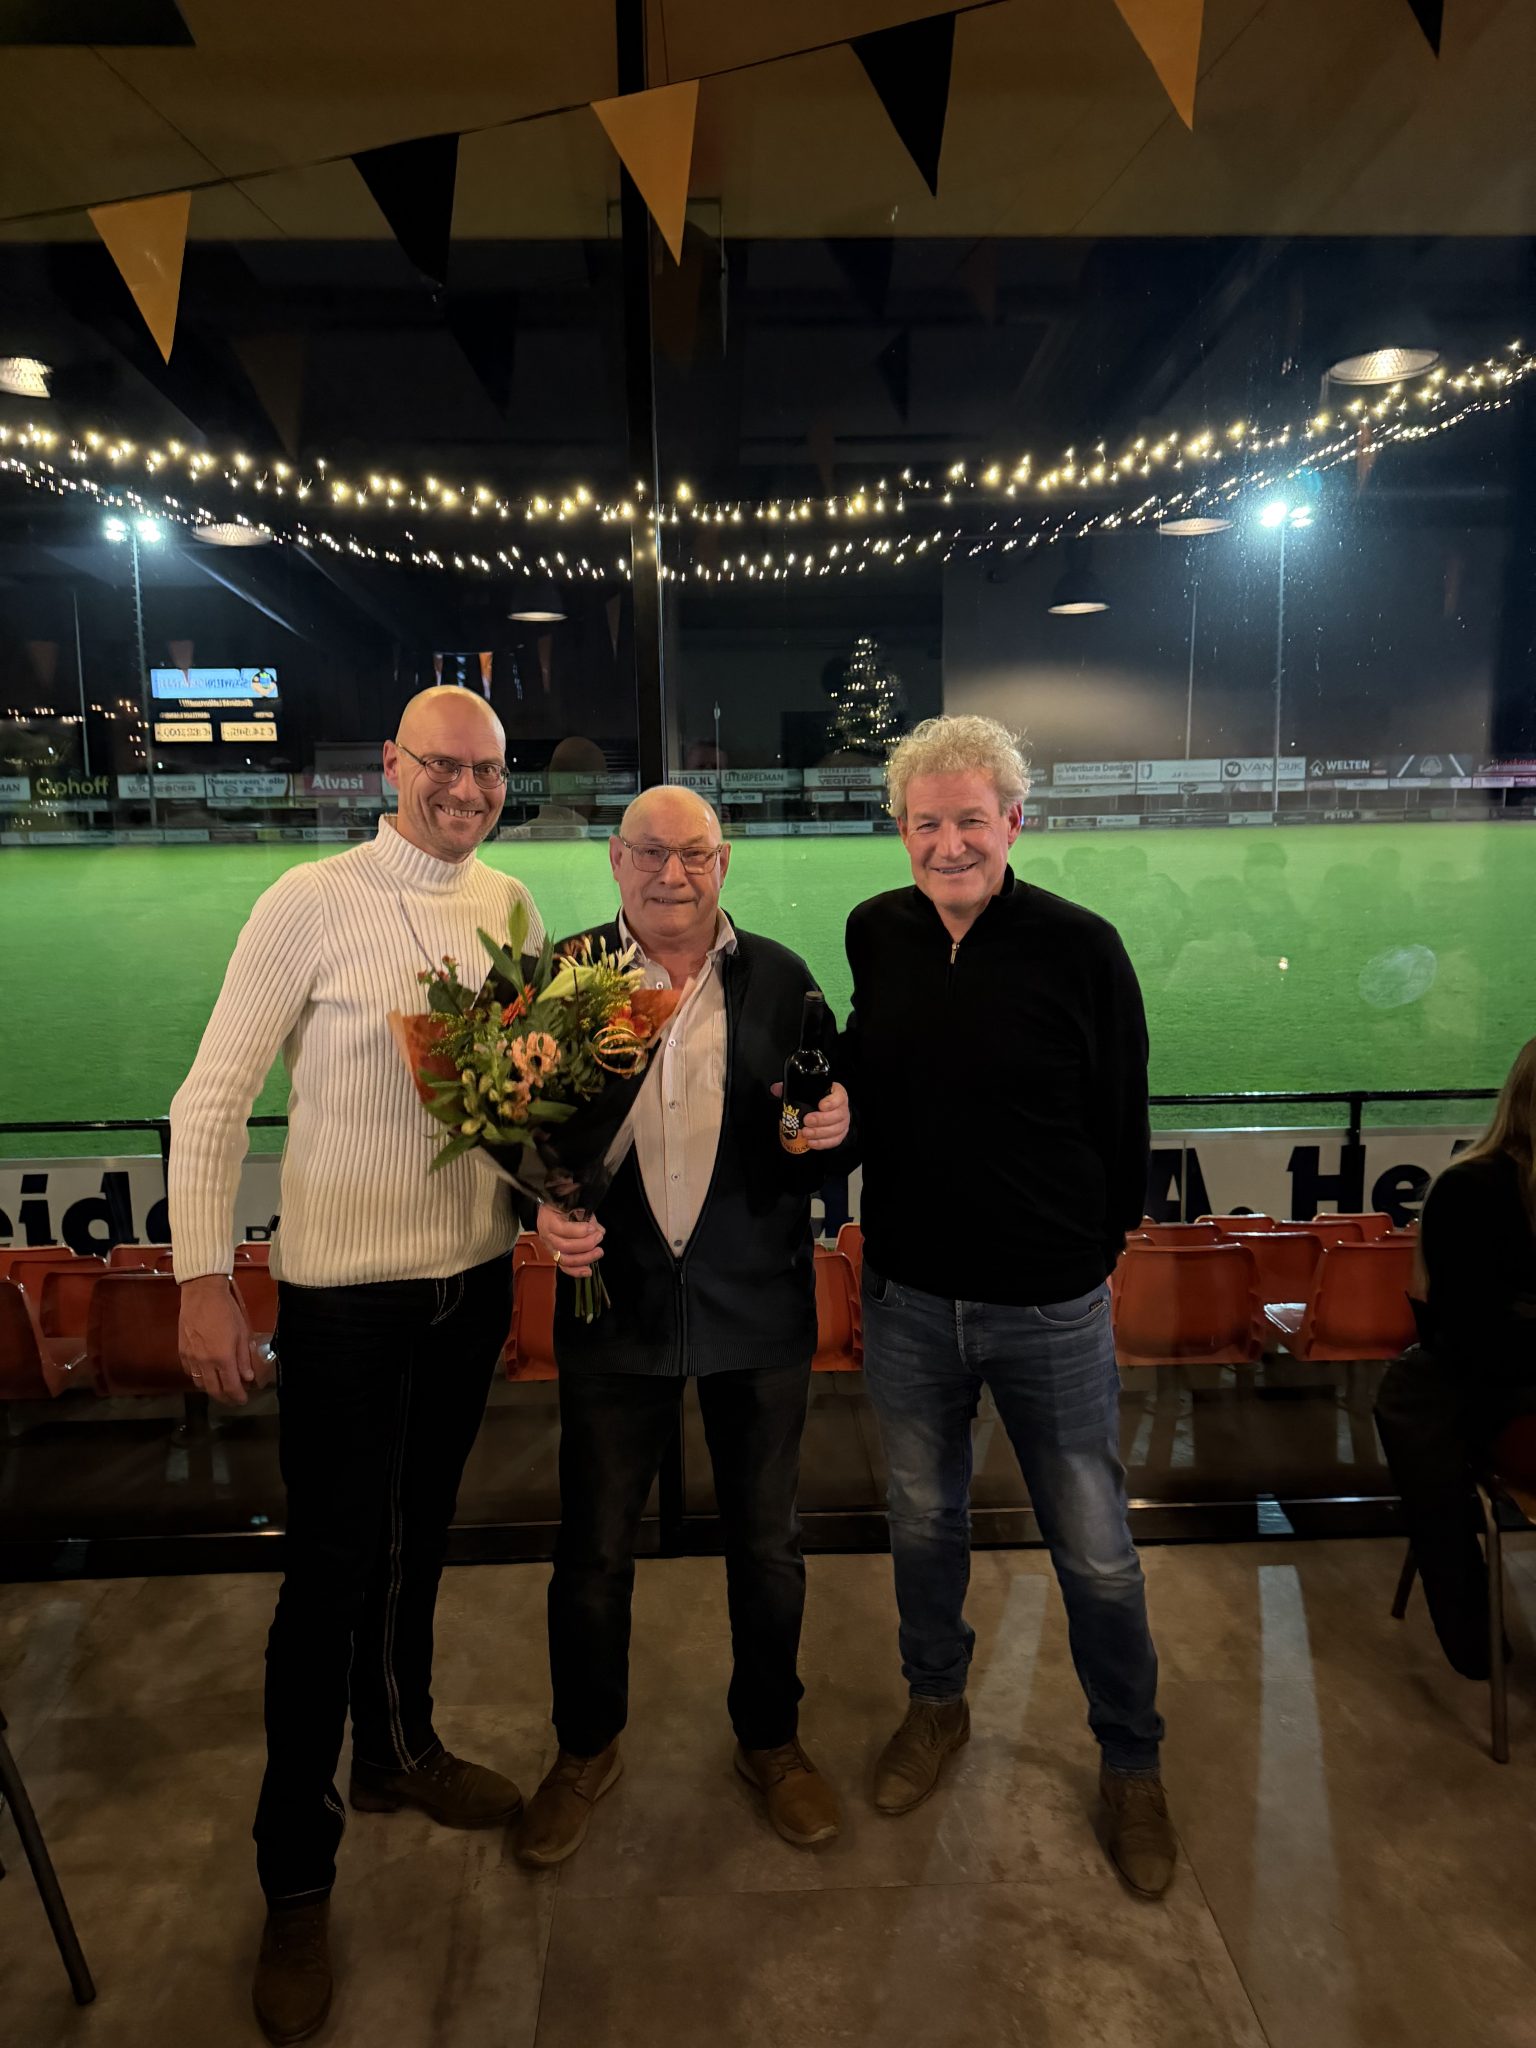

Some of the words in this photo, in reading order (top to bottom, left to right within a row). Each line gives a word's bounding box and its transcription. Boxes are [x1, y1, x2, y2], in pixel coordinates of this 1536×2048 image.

[1064, 763, 1101, 774] Ventura
[1102, 762, 1134, 774] Design
[1243, 762, 1273, 772] VAN
[1326, 759, 1370, 772] WELTEN
[35, 776, 109, 798] Ophoff
[311, 774, 364, 790] Alvasi
[1324, 809, 1355, 820] PETRA
